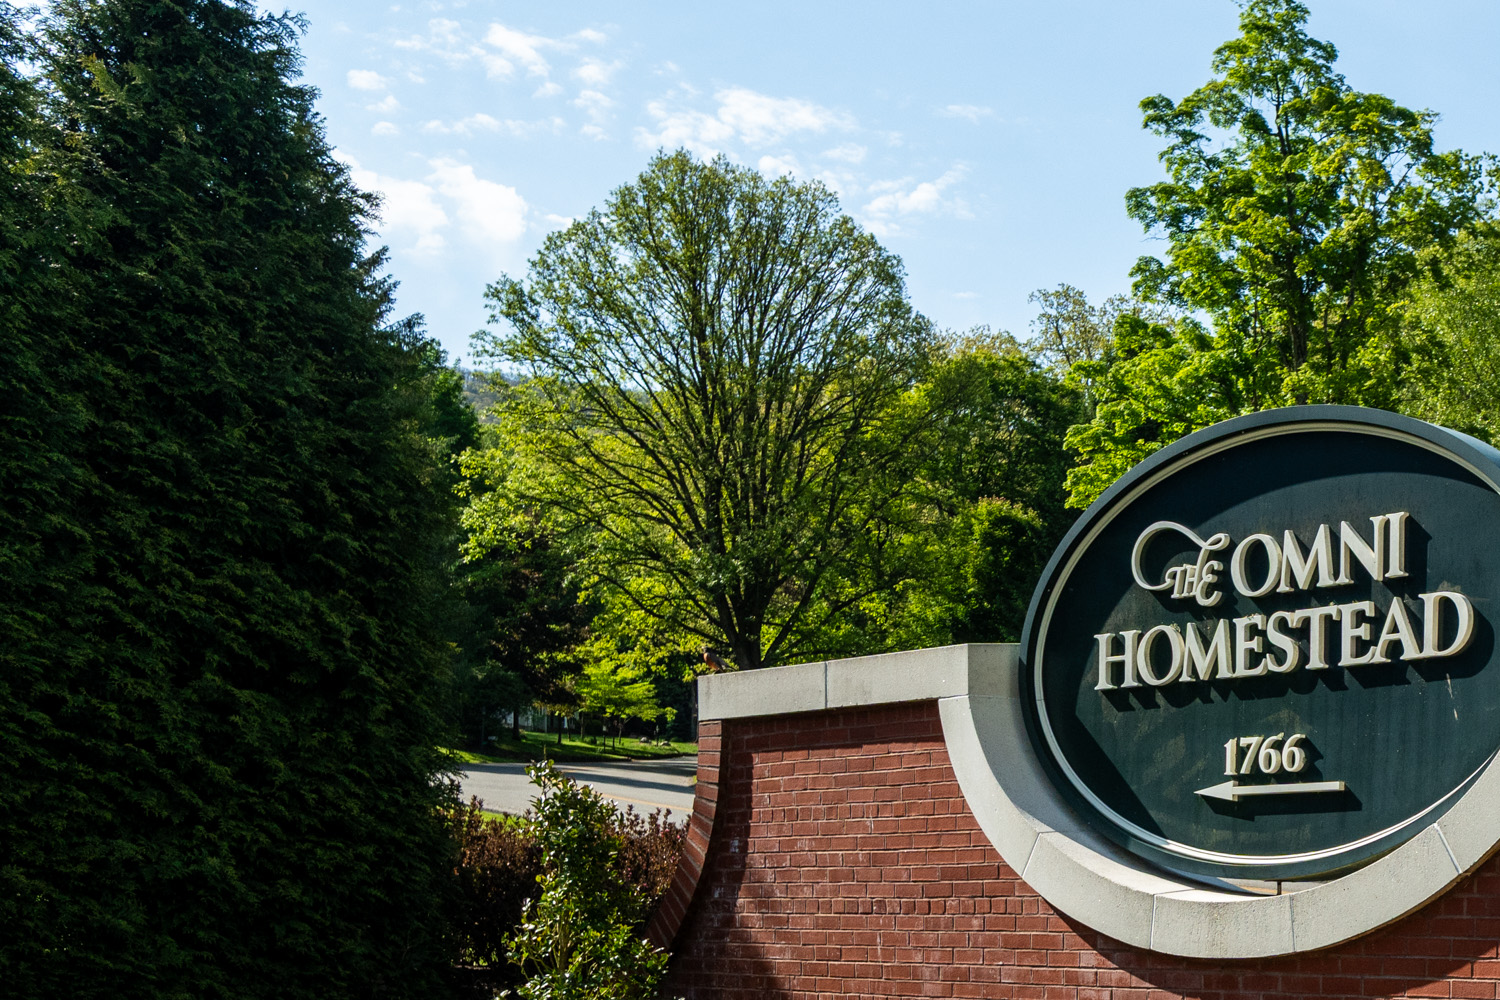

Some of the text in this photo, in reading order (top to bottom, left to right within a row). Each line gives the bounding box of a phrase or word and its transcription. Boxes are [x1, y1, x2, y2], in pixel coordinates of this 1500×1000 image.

[1231, 511, 1411, 598] OMNI
[1094, 591, 1475, 690] HOMESTEAD
[1223, 732, 1308, 777] 1766
